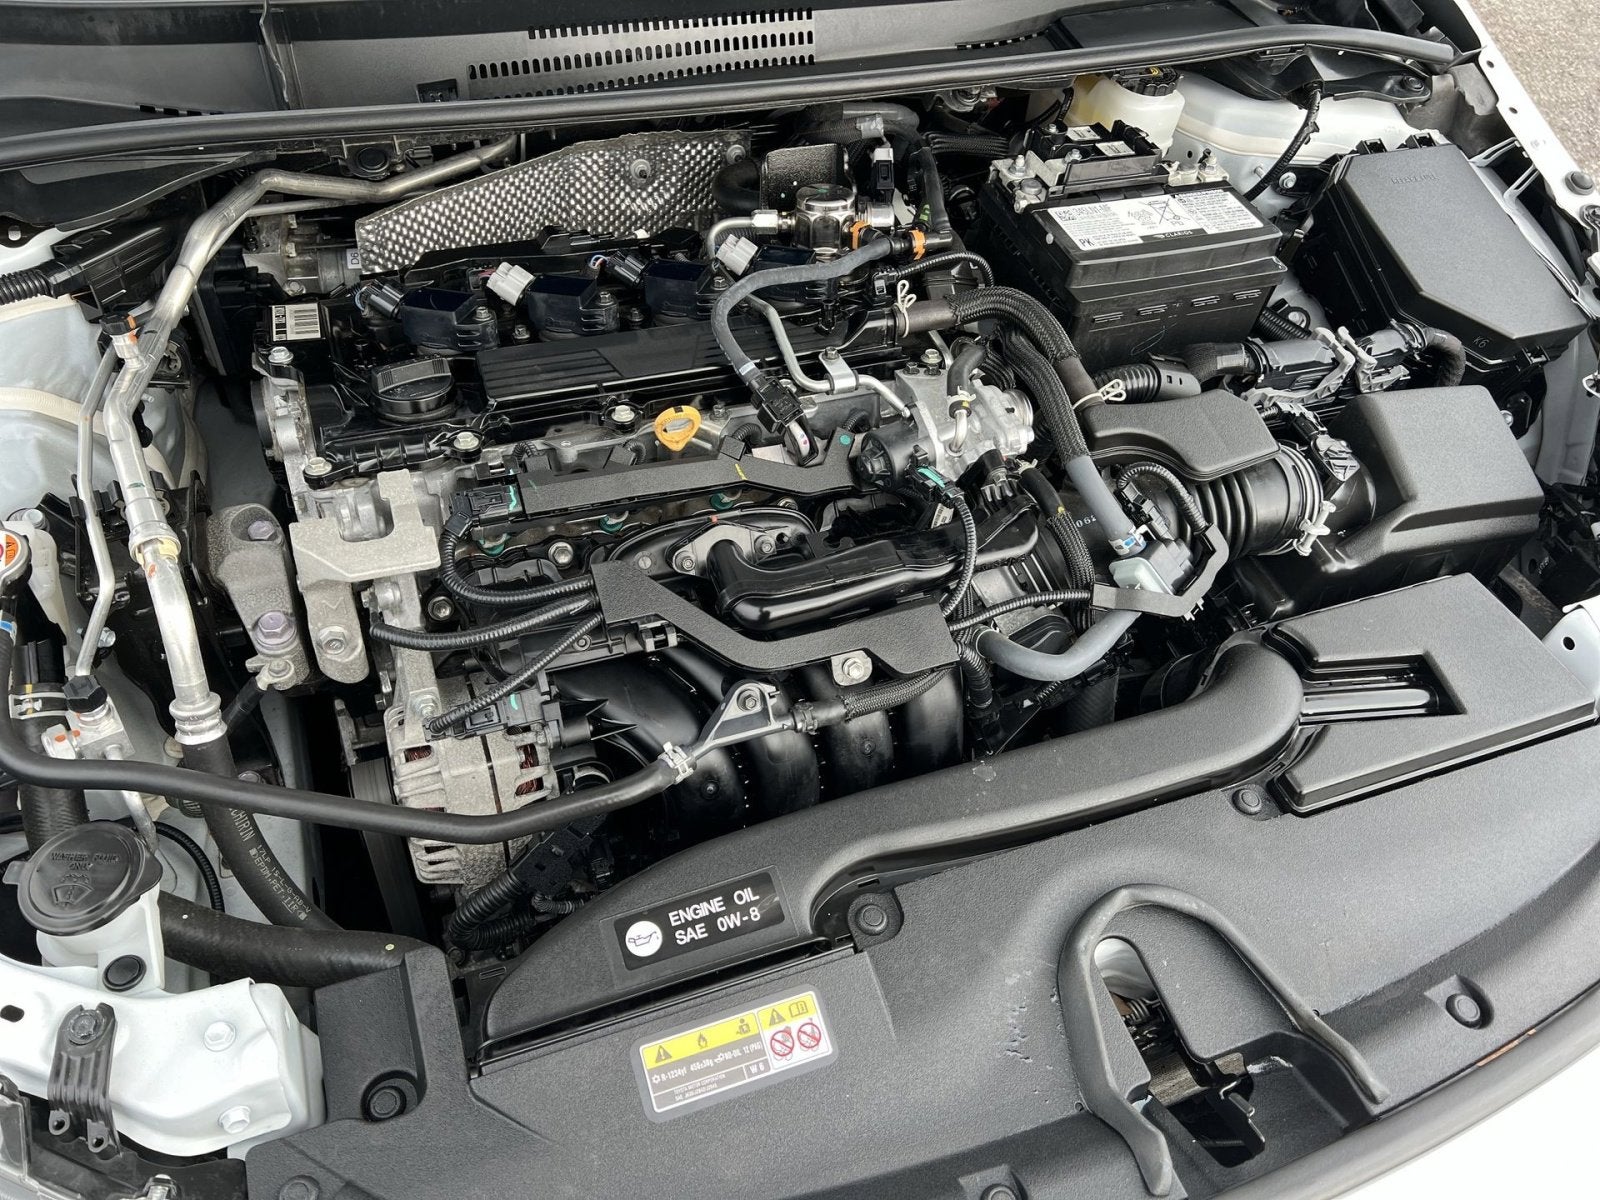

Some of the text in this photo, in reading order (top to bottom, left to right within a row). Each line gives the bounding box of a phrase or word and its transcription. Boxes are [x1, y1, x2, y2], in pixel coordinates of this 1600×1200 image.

[1079, 238, 1095, 247] PK
[668, 886, 760, 927] ENGINE OIL
[674, 906, 761, 945] SAE 0W-8
